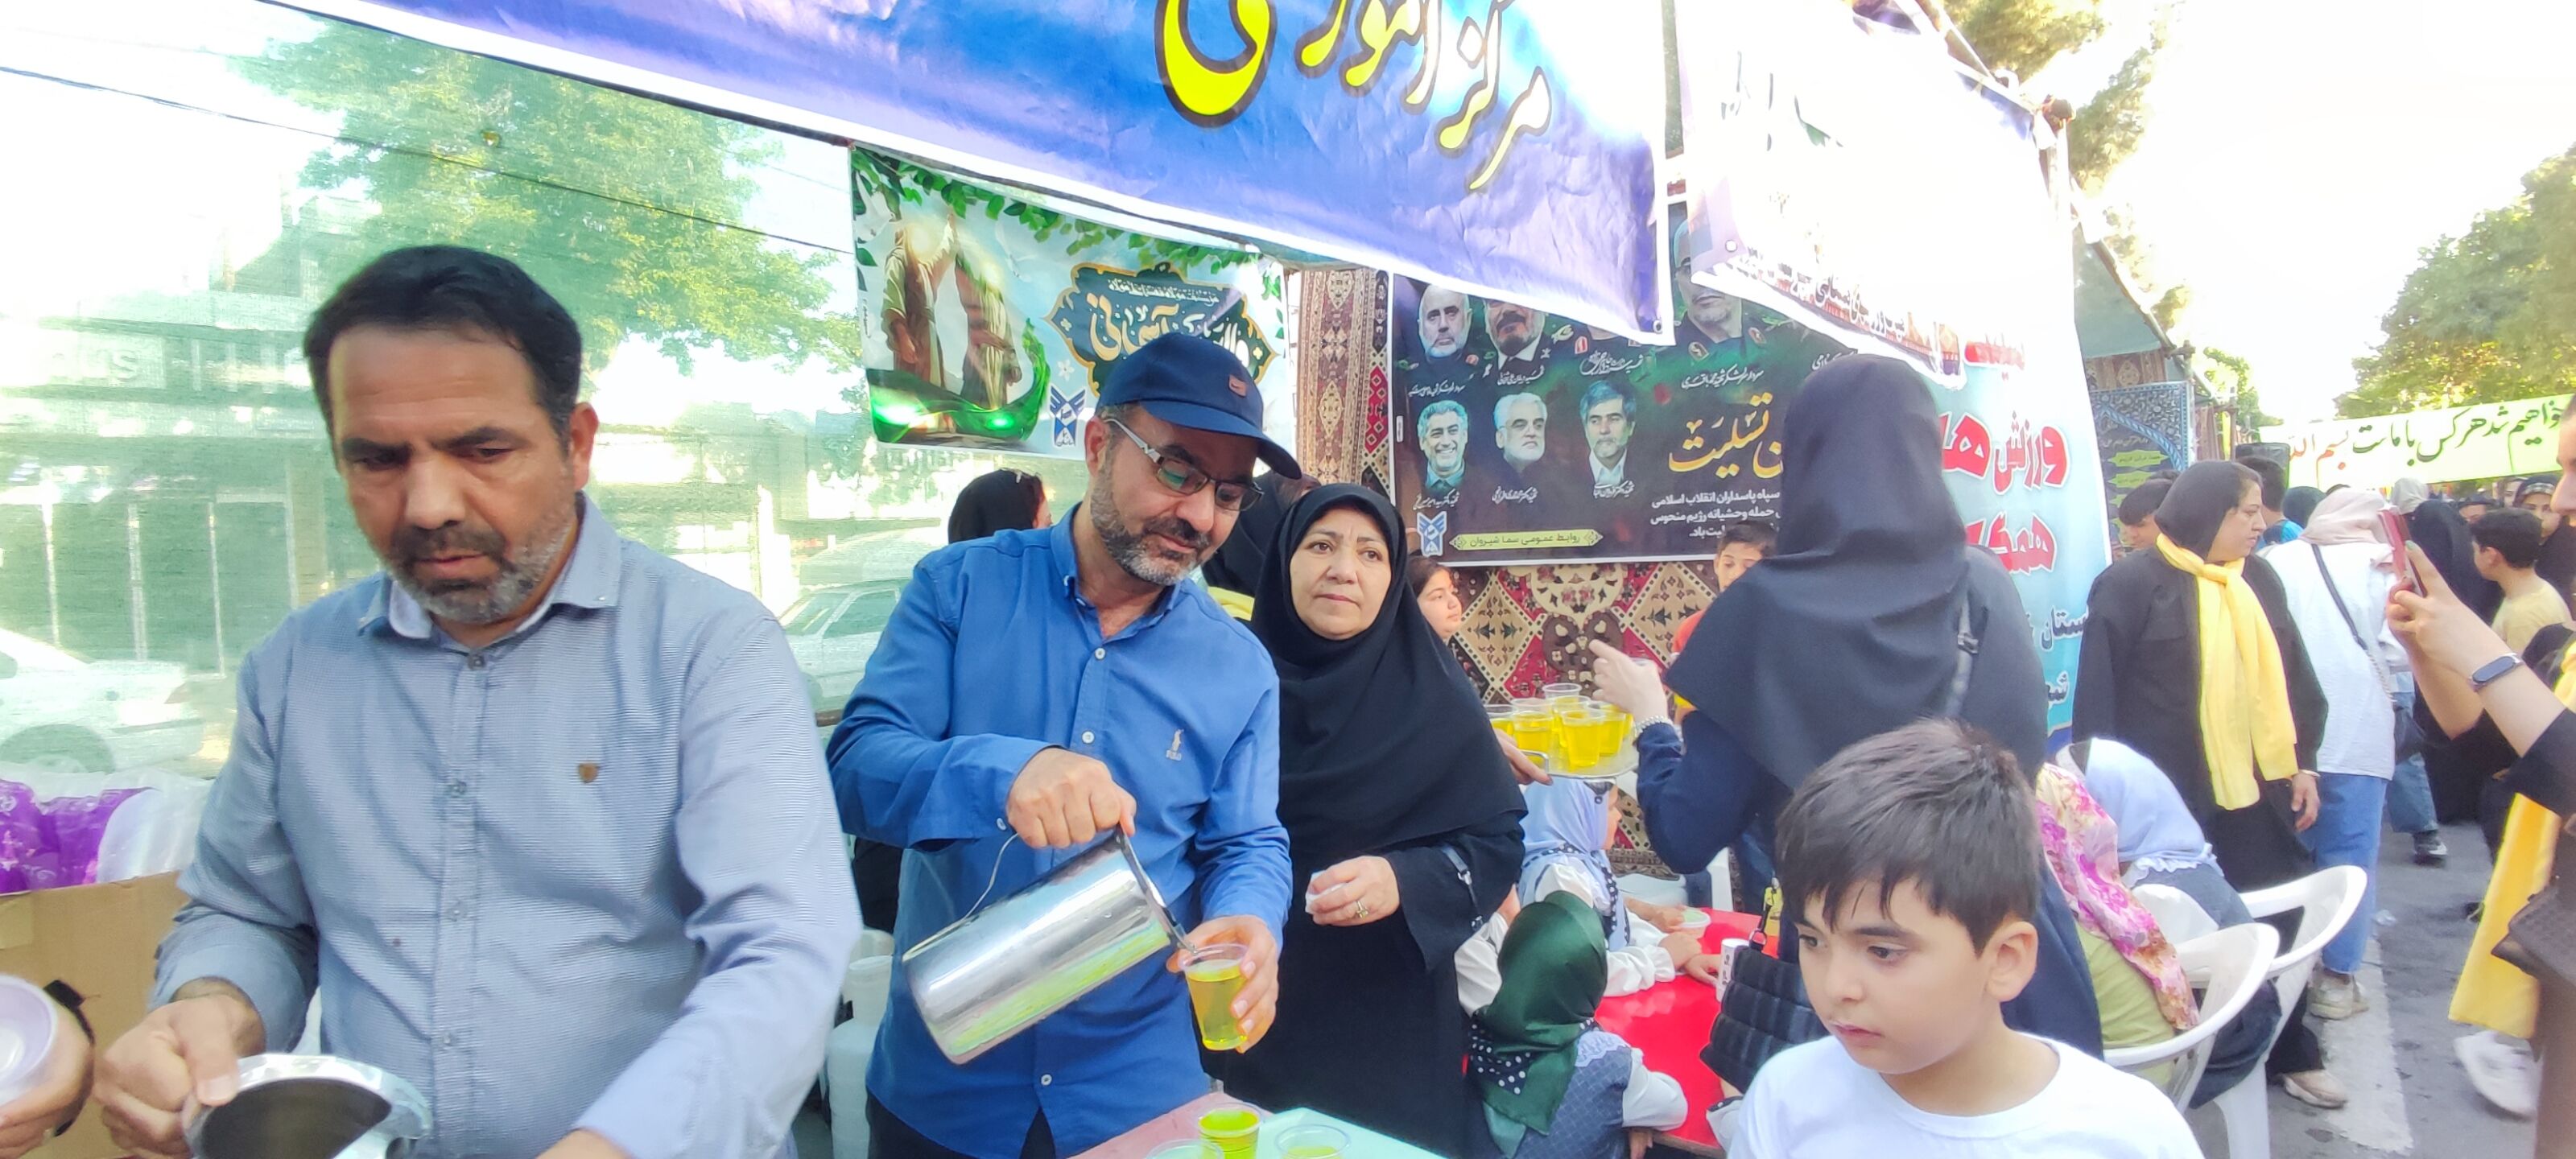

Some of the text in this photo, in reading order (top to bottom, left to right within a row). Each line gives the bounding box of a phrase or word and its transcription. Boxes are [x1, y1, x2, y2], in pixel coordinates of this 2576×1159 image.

[1669, 392, 1773, 479] تسلیت
[2316, 429, 2349, 490] بسم
[1651, 493, 1685, 509] اسلامی
[1686, 492, 1716, 506] انقلاب
[1716, 489, 1757, 505] پاسداران
[1707, 508, 1748, 522] وحشیانه
[1748, 505, 1774, 518] حمله
[1650, 512, 1686, 526] منحوس
[1470, 535, 1500, 547] شیروان
[1521, 534, 1554, 546] عمومی
[1556, 532, 1580, 544] روابط
